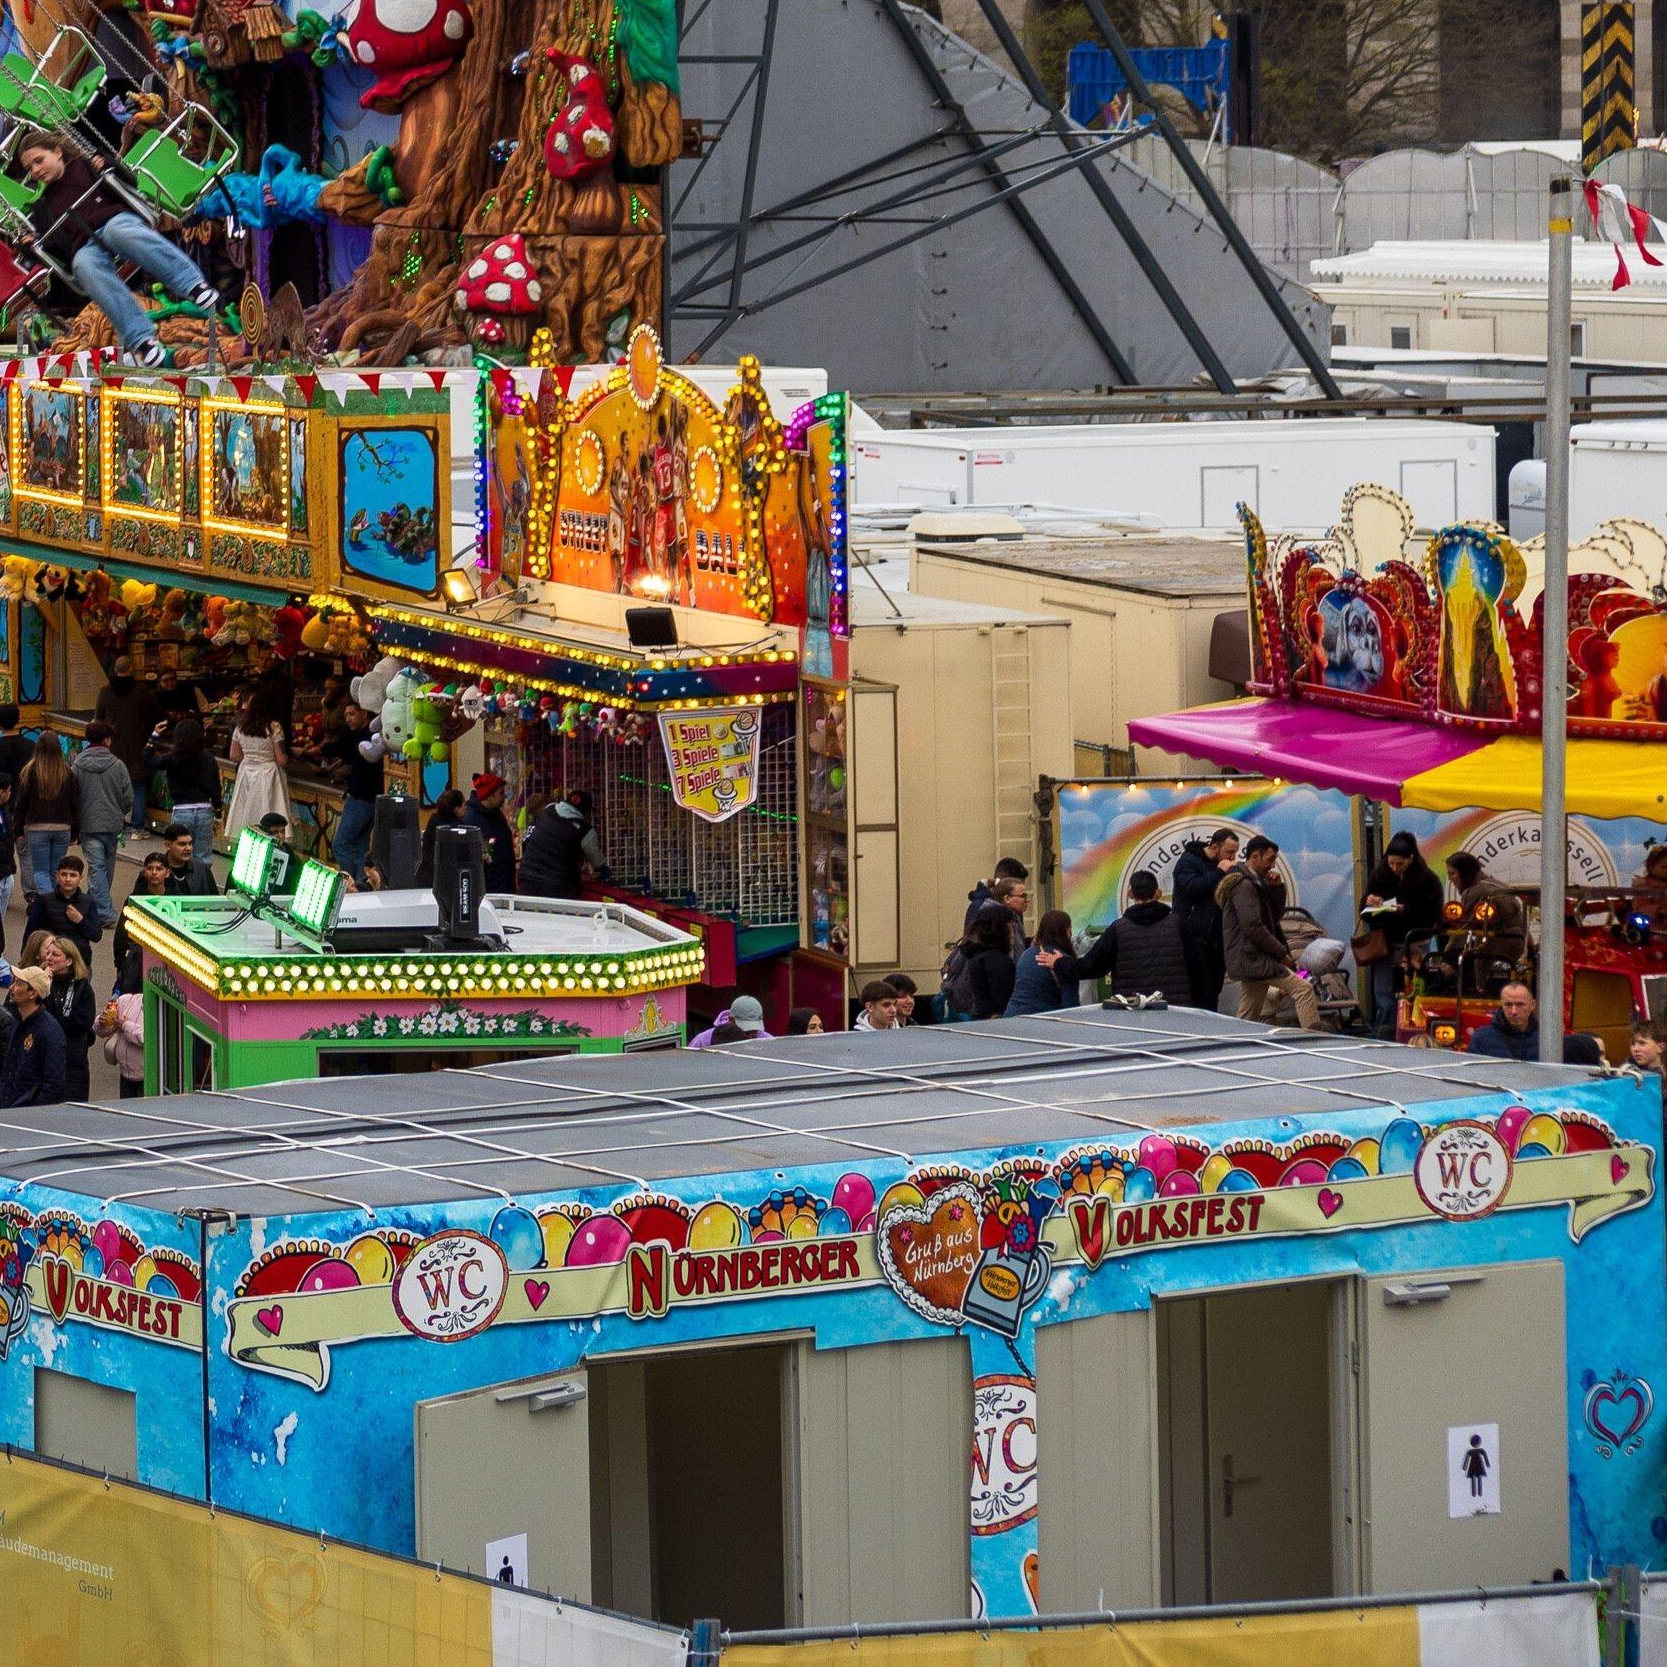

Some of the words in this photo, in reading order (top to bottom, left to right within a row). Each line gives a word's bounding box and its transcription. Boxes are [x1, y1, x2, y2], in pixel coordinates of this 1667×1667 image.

[669, 724, 677, 743] 1
[679, 723, 711, 746] Spiel
[672, 749, 681, 769] 3
[682, 746, 719, 770] Spiele
[676, 774, 685, 798] 7
[687, 767, 721, 796] Spiele
[1476, 826, 1605, 882] nderkassell
[1436, 1151, 1492, 1192] WC
[633, 1241, 859, 1315] NÜRNBERGER
[1075, 1194, 1265, 1265] VOLKSFEST
[905, 1234, 942, 1264] Gruß
[947, 1228, 973, 1247] aus
[914, 1251, 975, 1283] Nürnberg
[46, 1263, 183, 1337] VOLKSFEST
[418, 1266, 488, 1314] WC
[78, 1579, 113, 1601] GmbH
